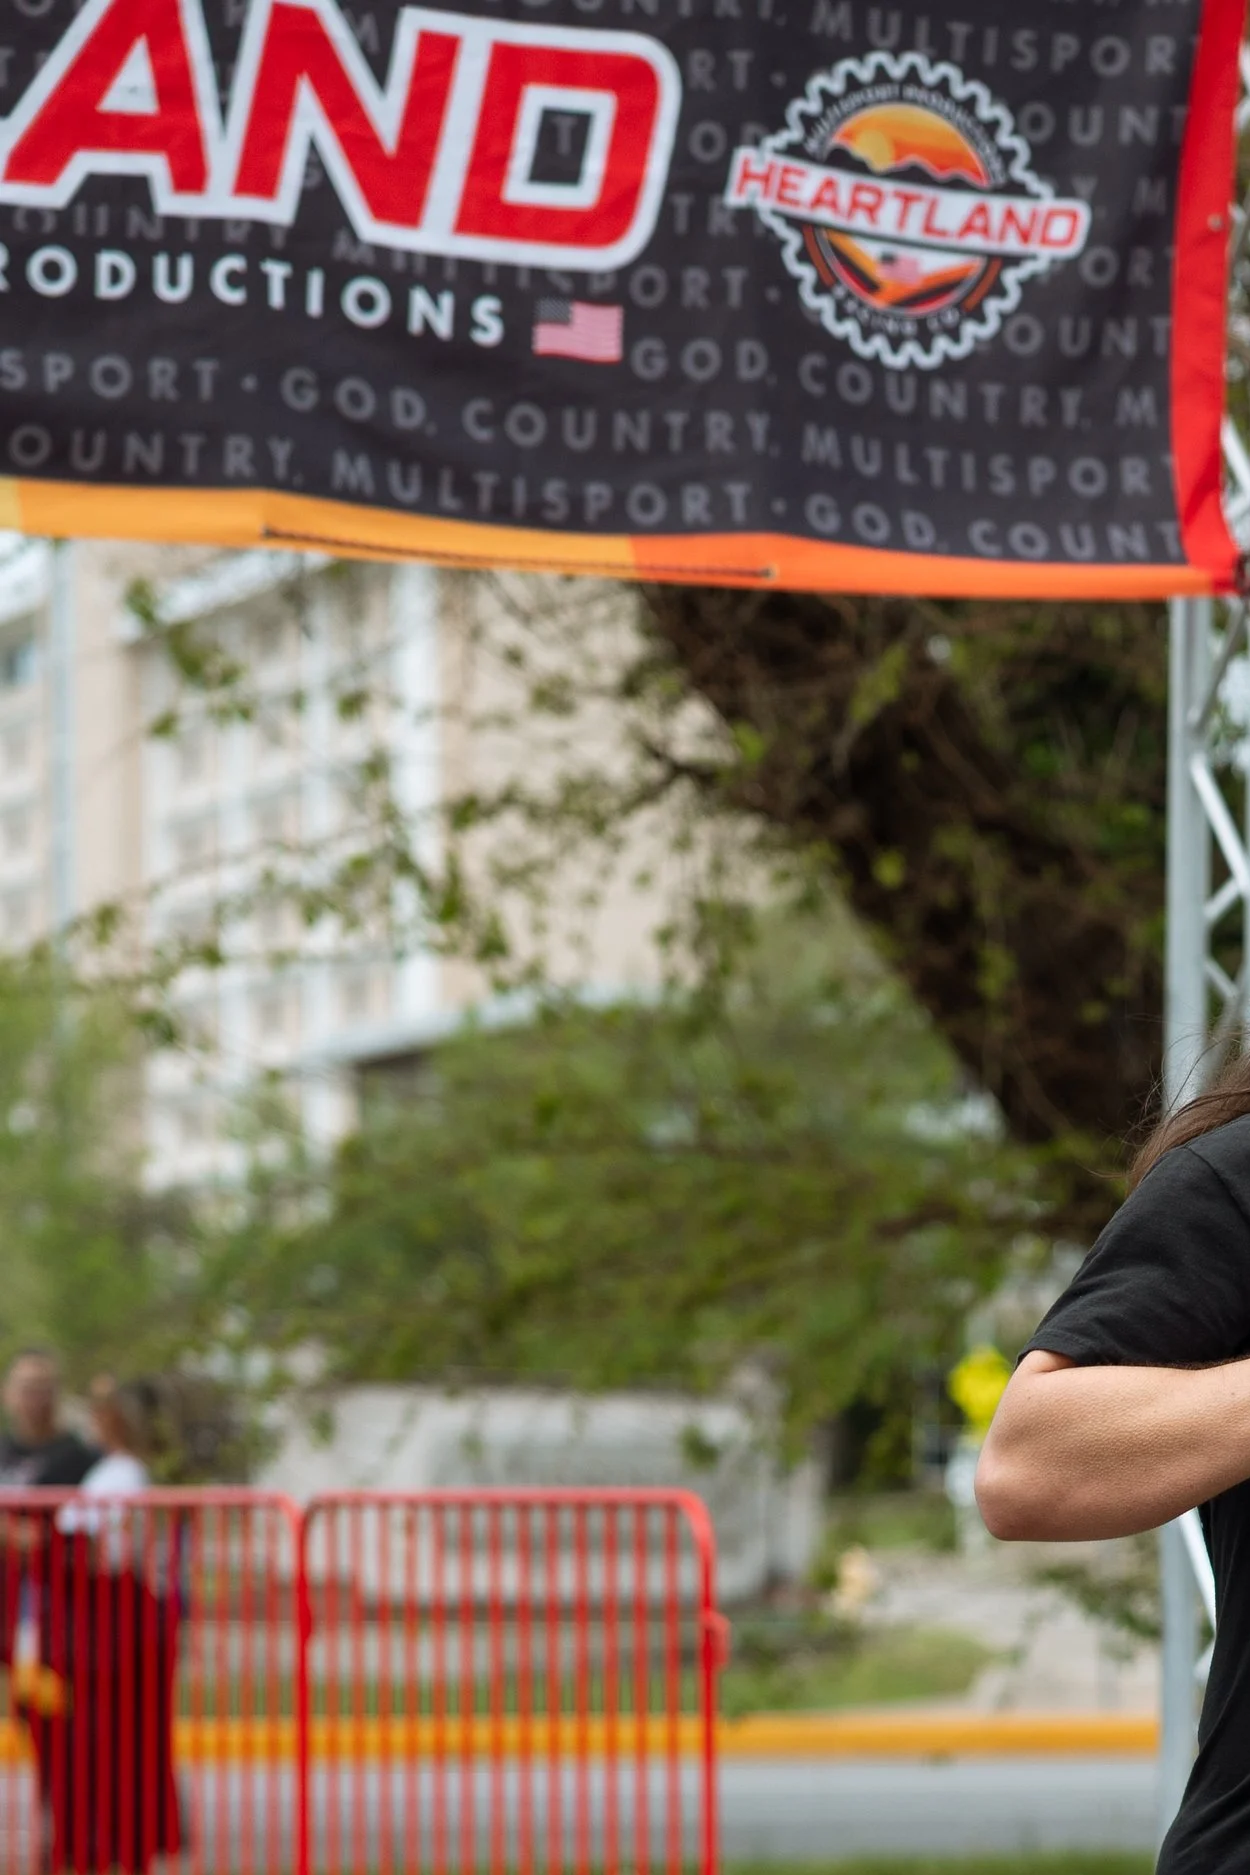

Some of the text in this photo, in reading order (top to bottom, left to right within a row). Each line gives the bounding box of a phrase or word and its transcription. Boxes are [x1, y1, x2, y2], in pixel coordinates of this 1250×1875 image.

[735, 156, 1081, 249] HEARTLAND
[0, 241, 504, 346] ODUCTIONS
[331, 448, 753, 527] MULTISPORT
